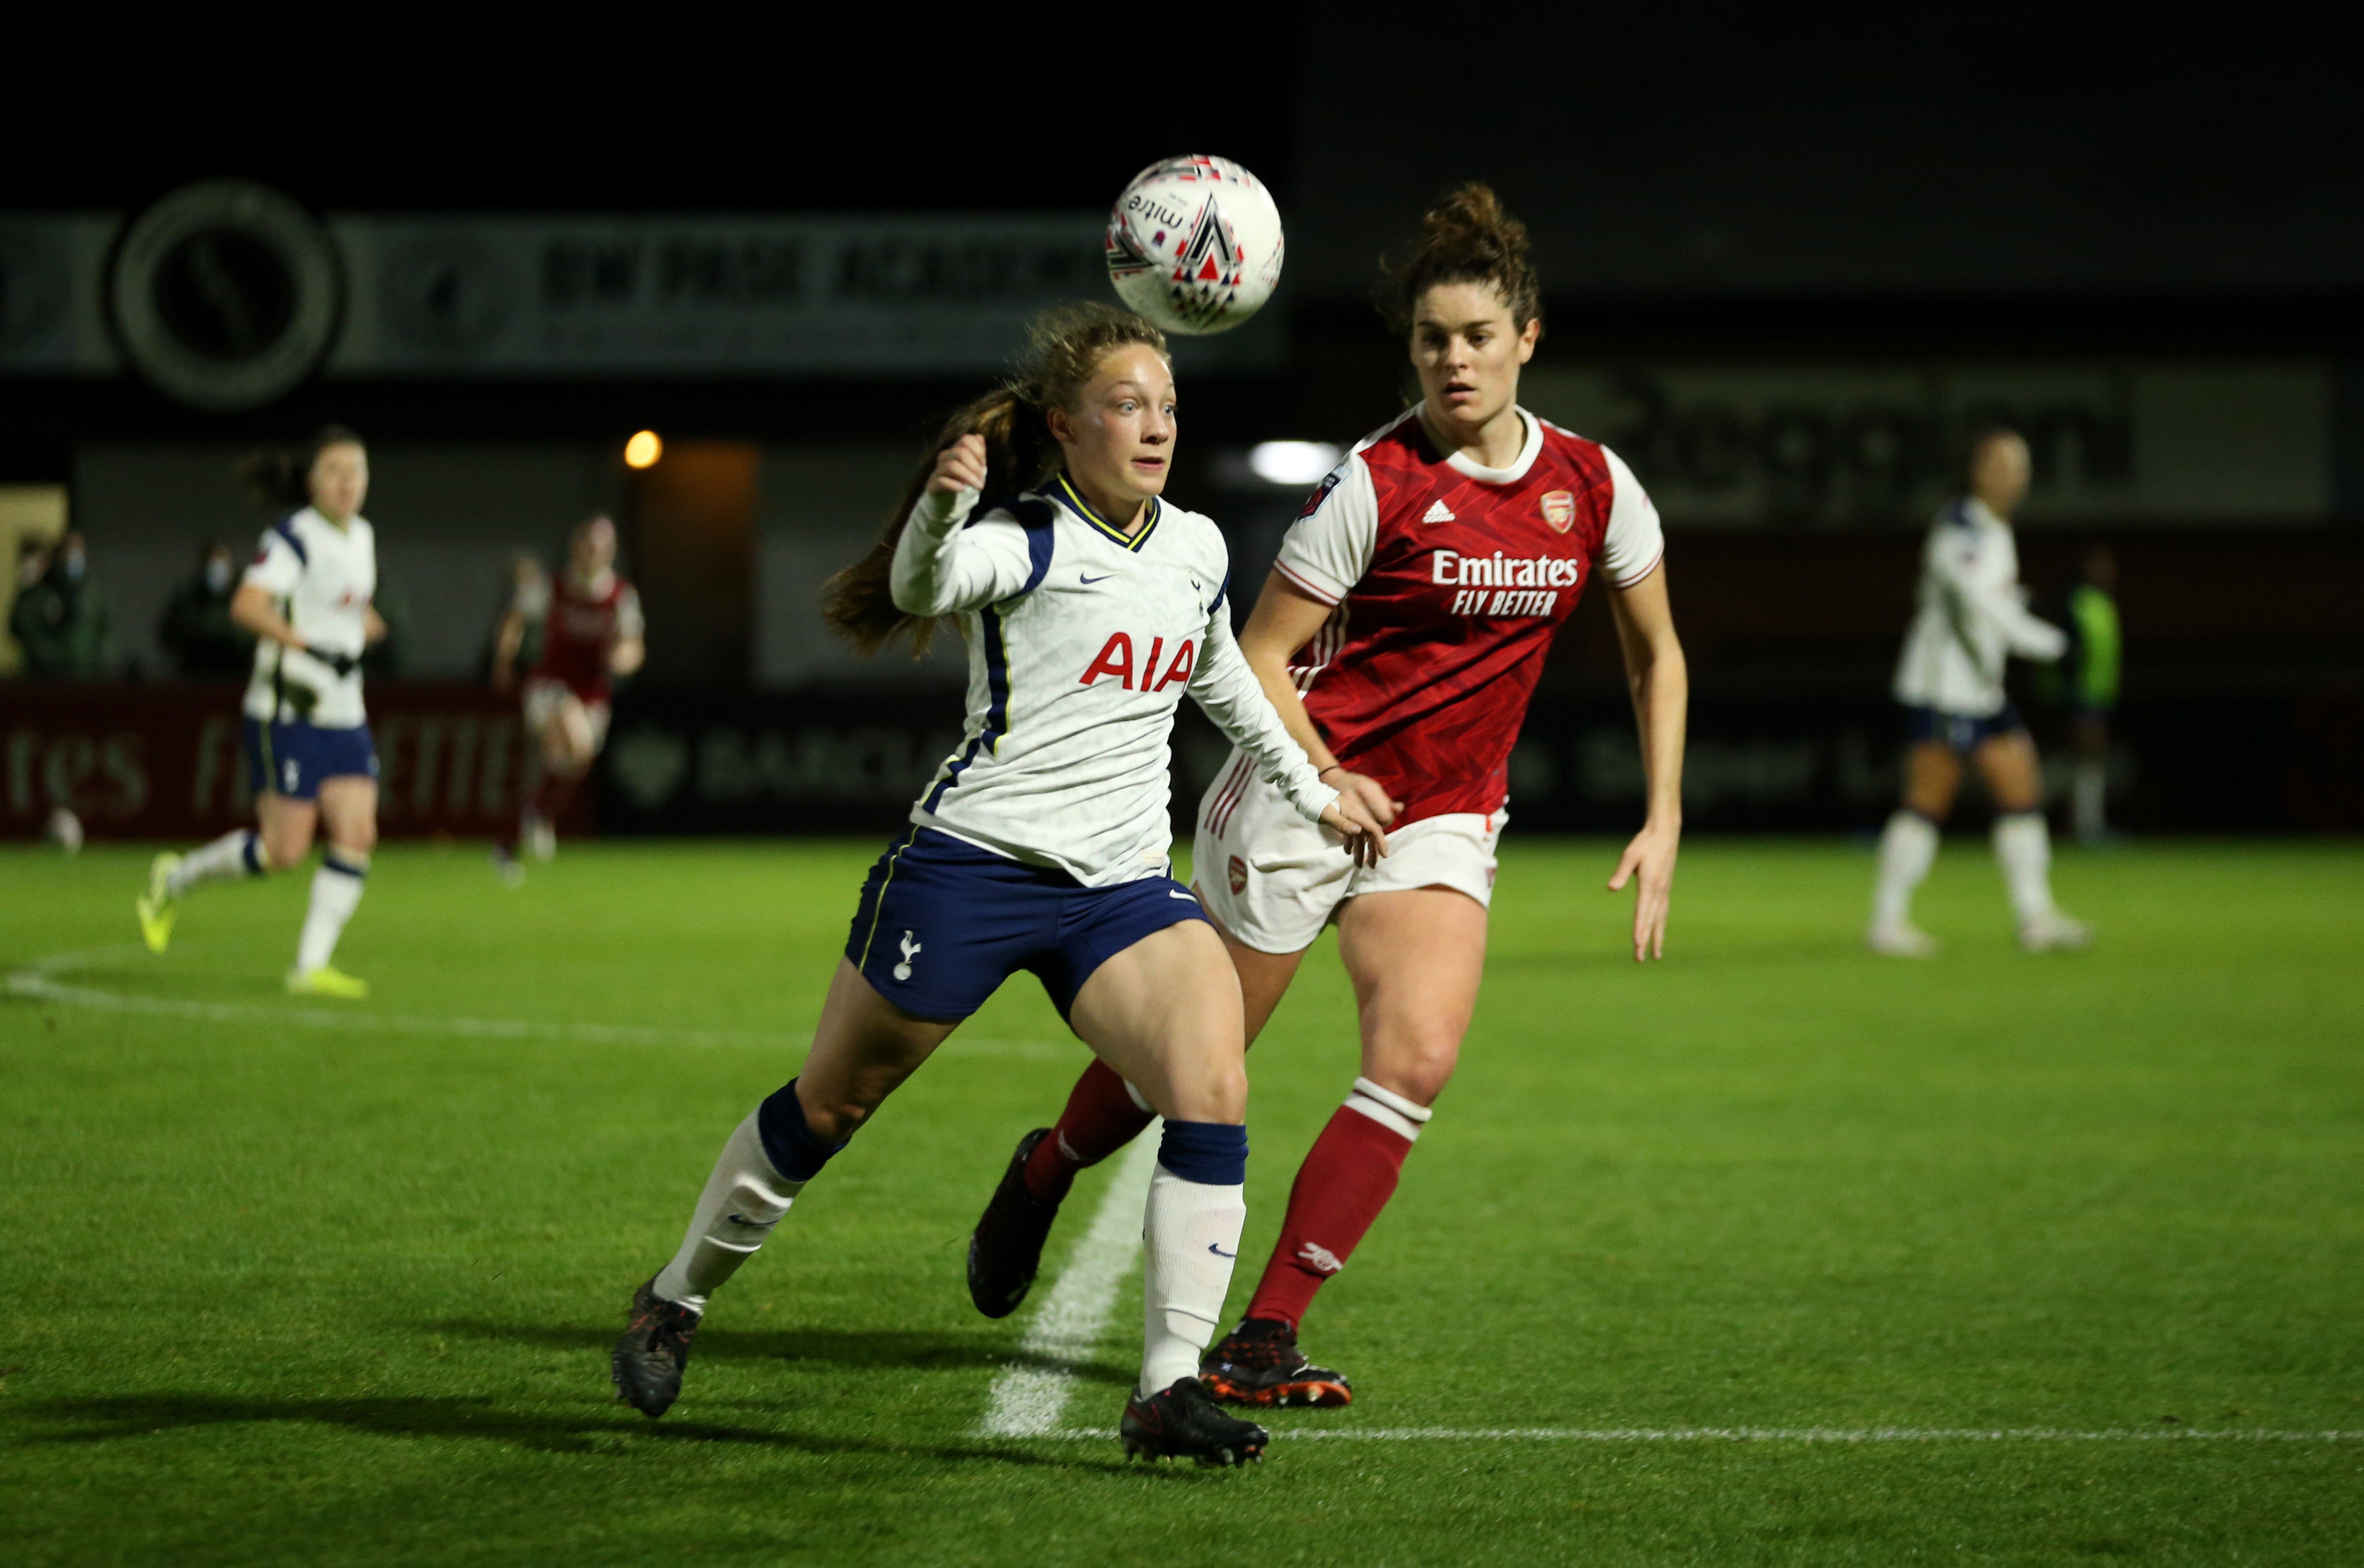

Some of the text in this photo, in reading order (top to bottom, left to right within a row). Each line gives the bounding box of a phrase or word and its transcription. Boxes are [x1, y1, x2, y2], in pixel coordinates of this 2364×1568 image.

[1128, 195, 1183, 228] mitre
[1432, 549, 1578, 587] Emirates
[1450, 589, 1558, 617] FLY BETTER
[1078, 631, 1194, 694] AIA
